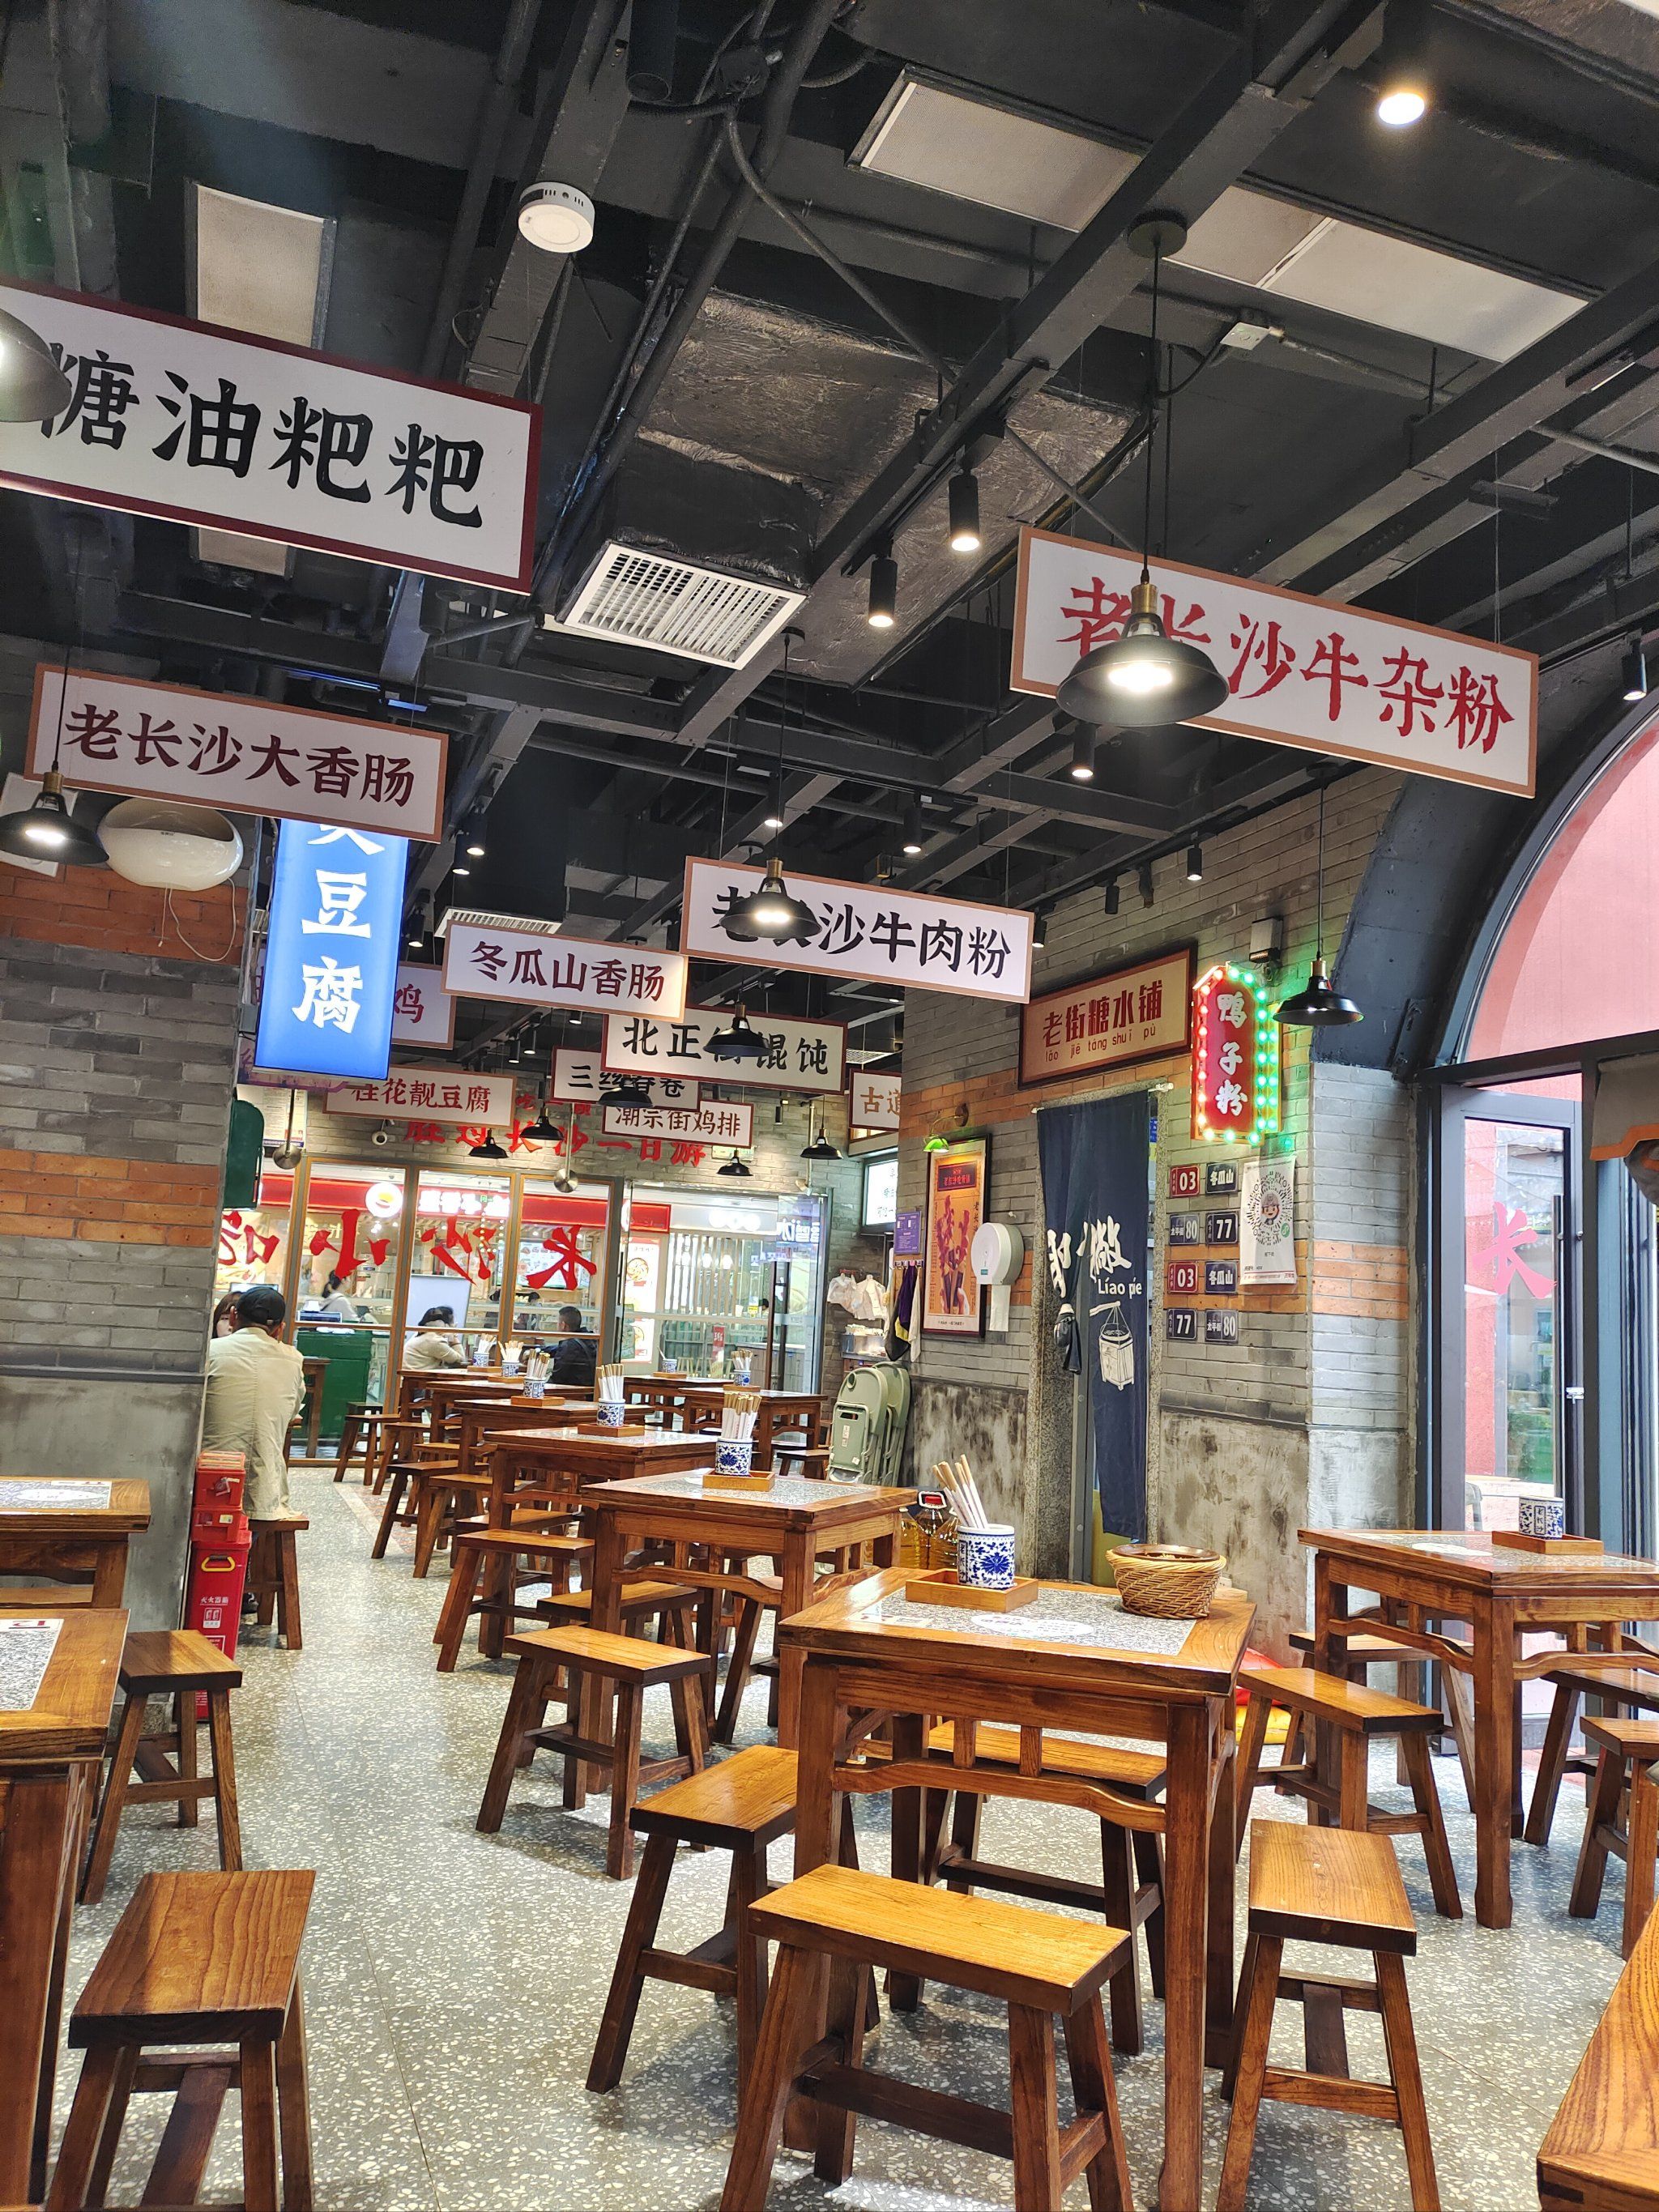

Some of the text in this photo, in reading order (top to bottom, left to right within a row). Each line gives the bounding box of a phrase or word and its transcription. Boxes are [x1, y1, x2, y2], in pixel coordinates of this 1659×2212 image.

[41, 342, 484, 528] 糖油粑粑
[64, 703, 415, 807] 老长沙大香肠
[711, 886, 1012, 979] 沙牛肉粉
[470, 940, 665, 1002] 冬瓜山香肠
[1043, 979, 1163, 1048] 老街糖水铺
[622, 1017, 829, 1075] 北正馄饨
[1214, 991, 1248, 1116] 鸭子粉
[615, 1106, 741, 1138] 潮宗街鸡排
[1179, 1171, 1196, 1191] 03
[1209, 1169, 1234, 1186] 冬瓜山
[1185, 1220, 1198, 1239] 80
[1216, 1218, 1233, 1239] 77
[1177, 1268, 1194, 1288] 03
[1209, 1269, 1234, 1285] 冬瓜山
[1176, 1314, 1192, 1334] 77
[1223, 1315, 1236, 1337] 80
